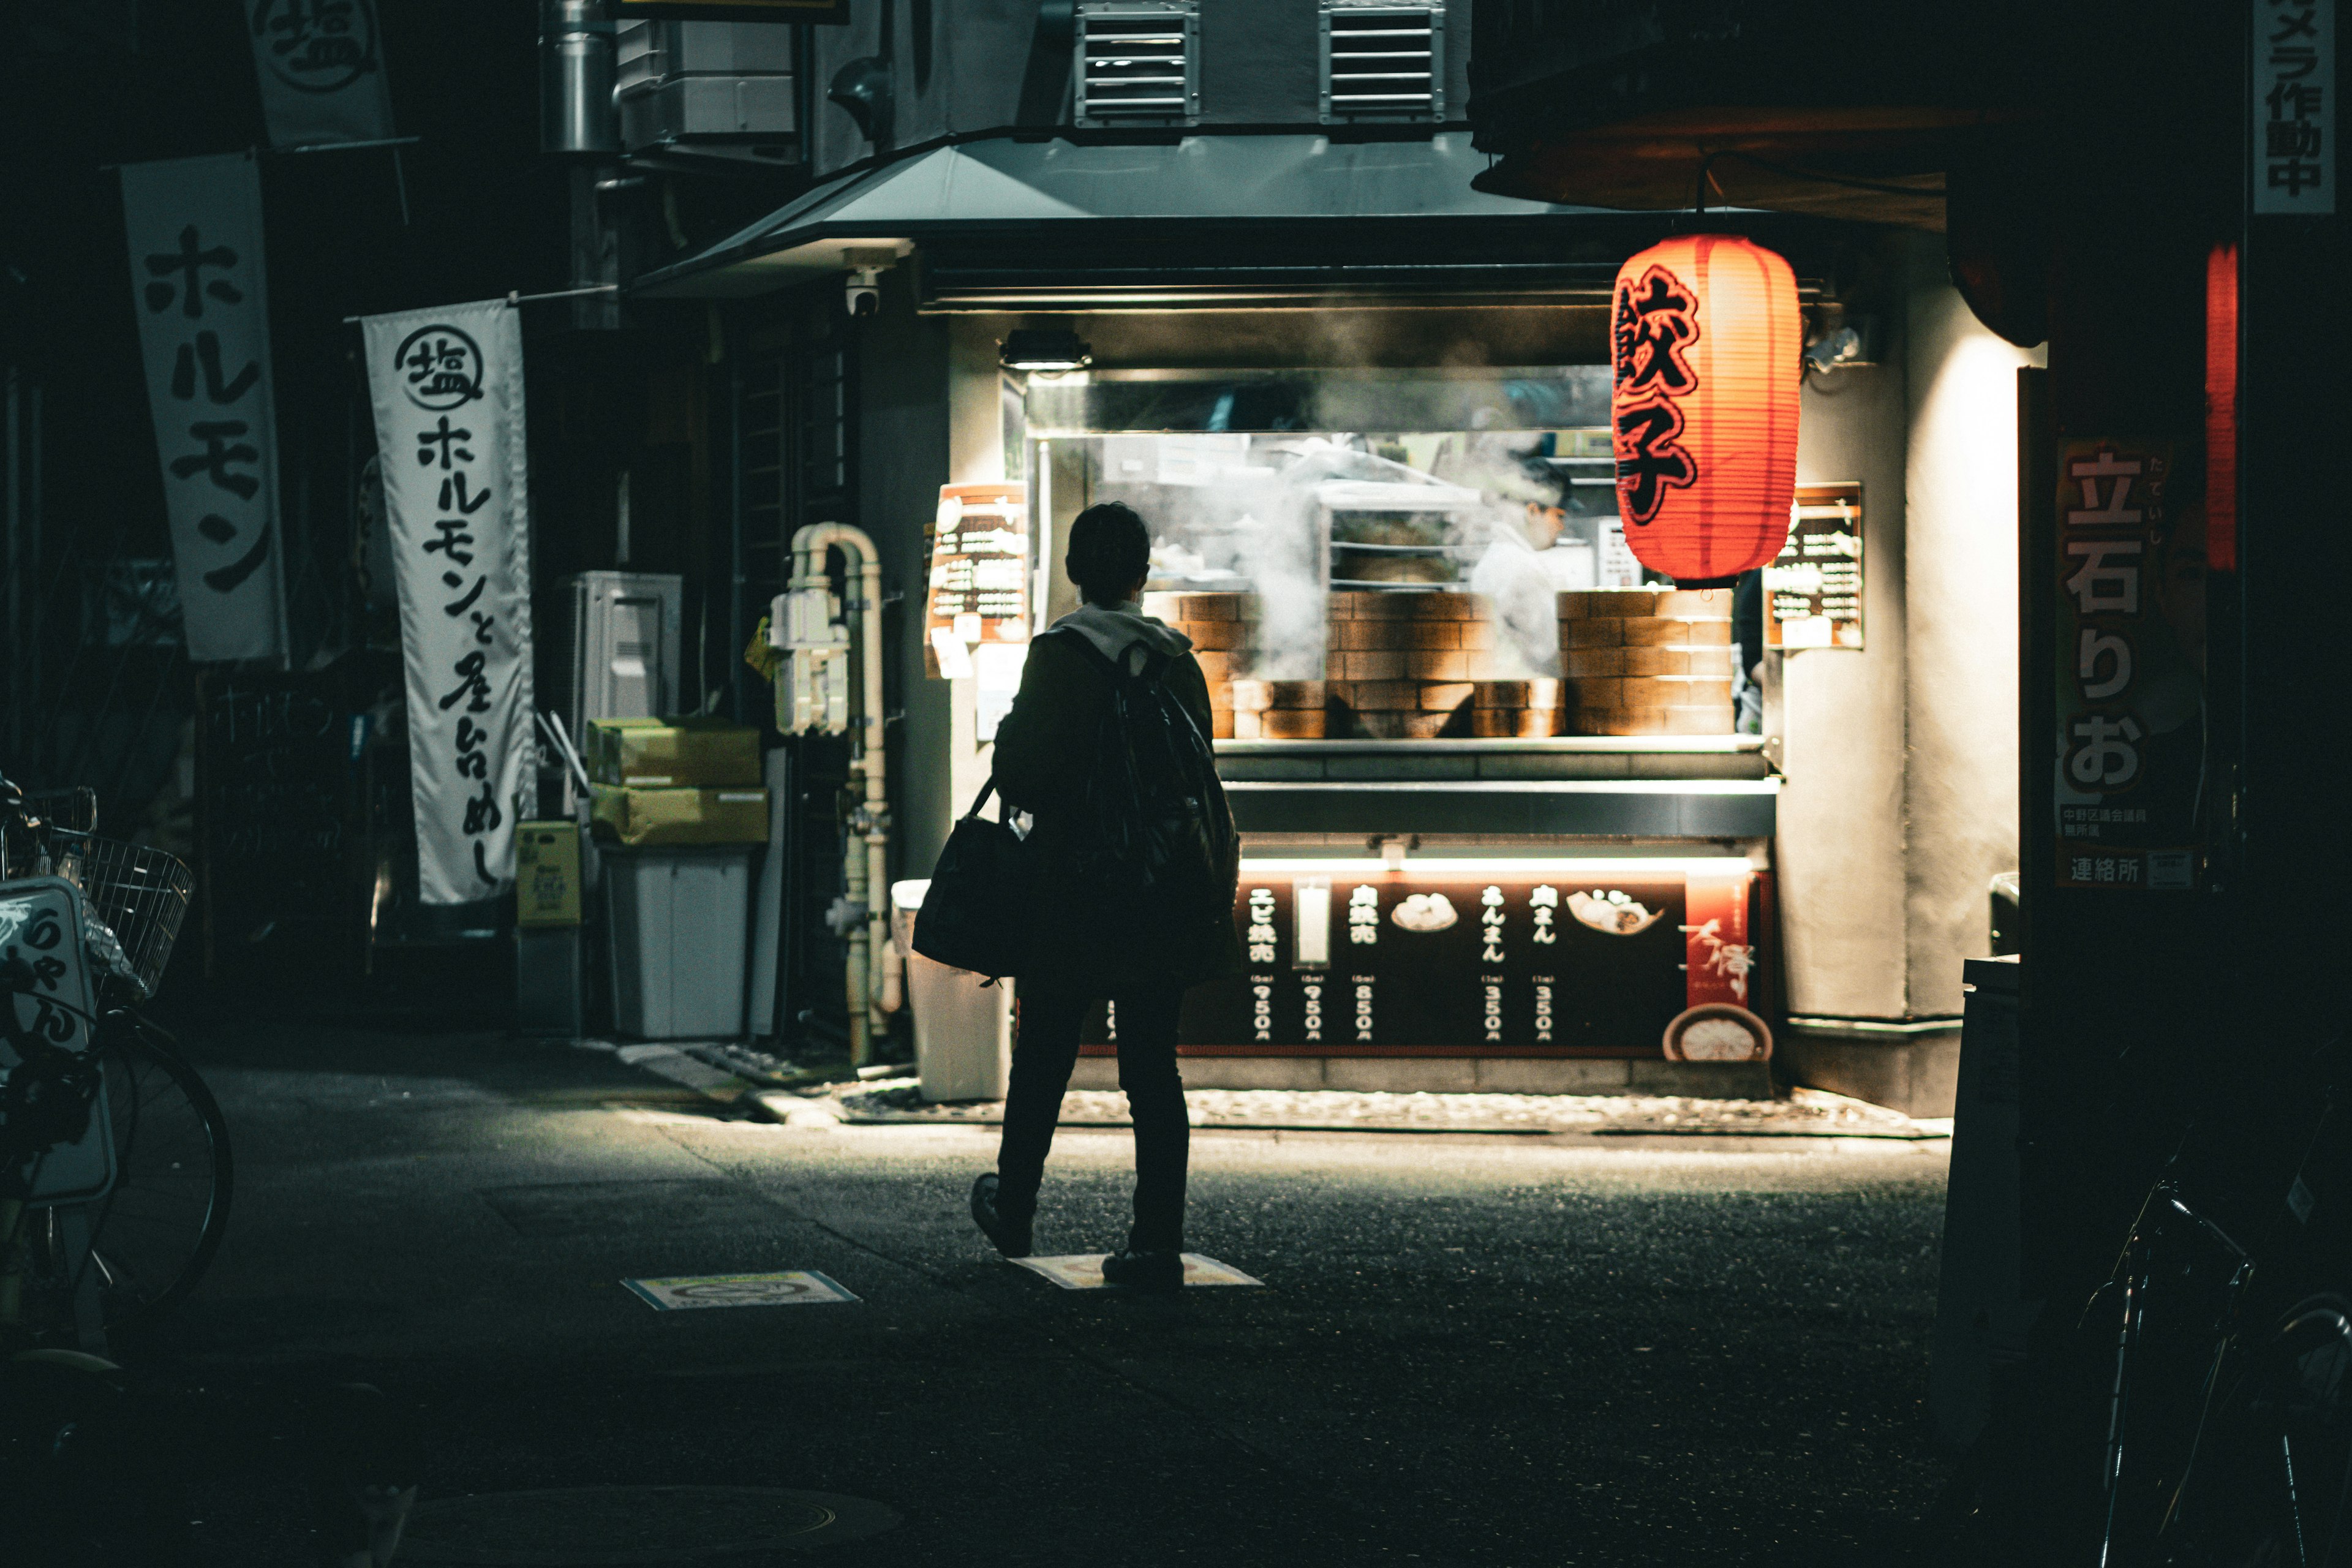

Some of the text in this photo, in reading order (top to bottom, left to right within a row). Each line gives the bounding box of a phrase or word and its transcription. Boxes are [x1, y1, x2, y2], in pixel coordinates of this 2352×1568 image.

[2266, 0, 2323, 197] メラ作動中
[144, 224, 271, 593] ホルモン
[1615, 264, 1700, 526] 餃子
[2148, 457, 2163, 545] たていし
[2066, 452, 2142, 786] 立石りお
[2063, 808, 2147, 823] 中野区議会議員
[2064, 824, 2100, 838] 無所属
[2071, 858, 2139, 883] 連絡所
[1481, 885, 1506, 963] あんまん
